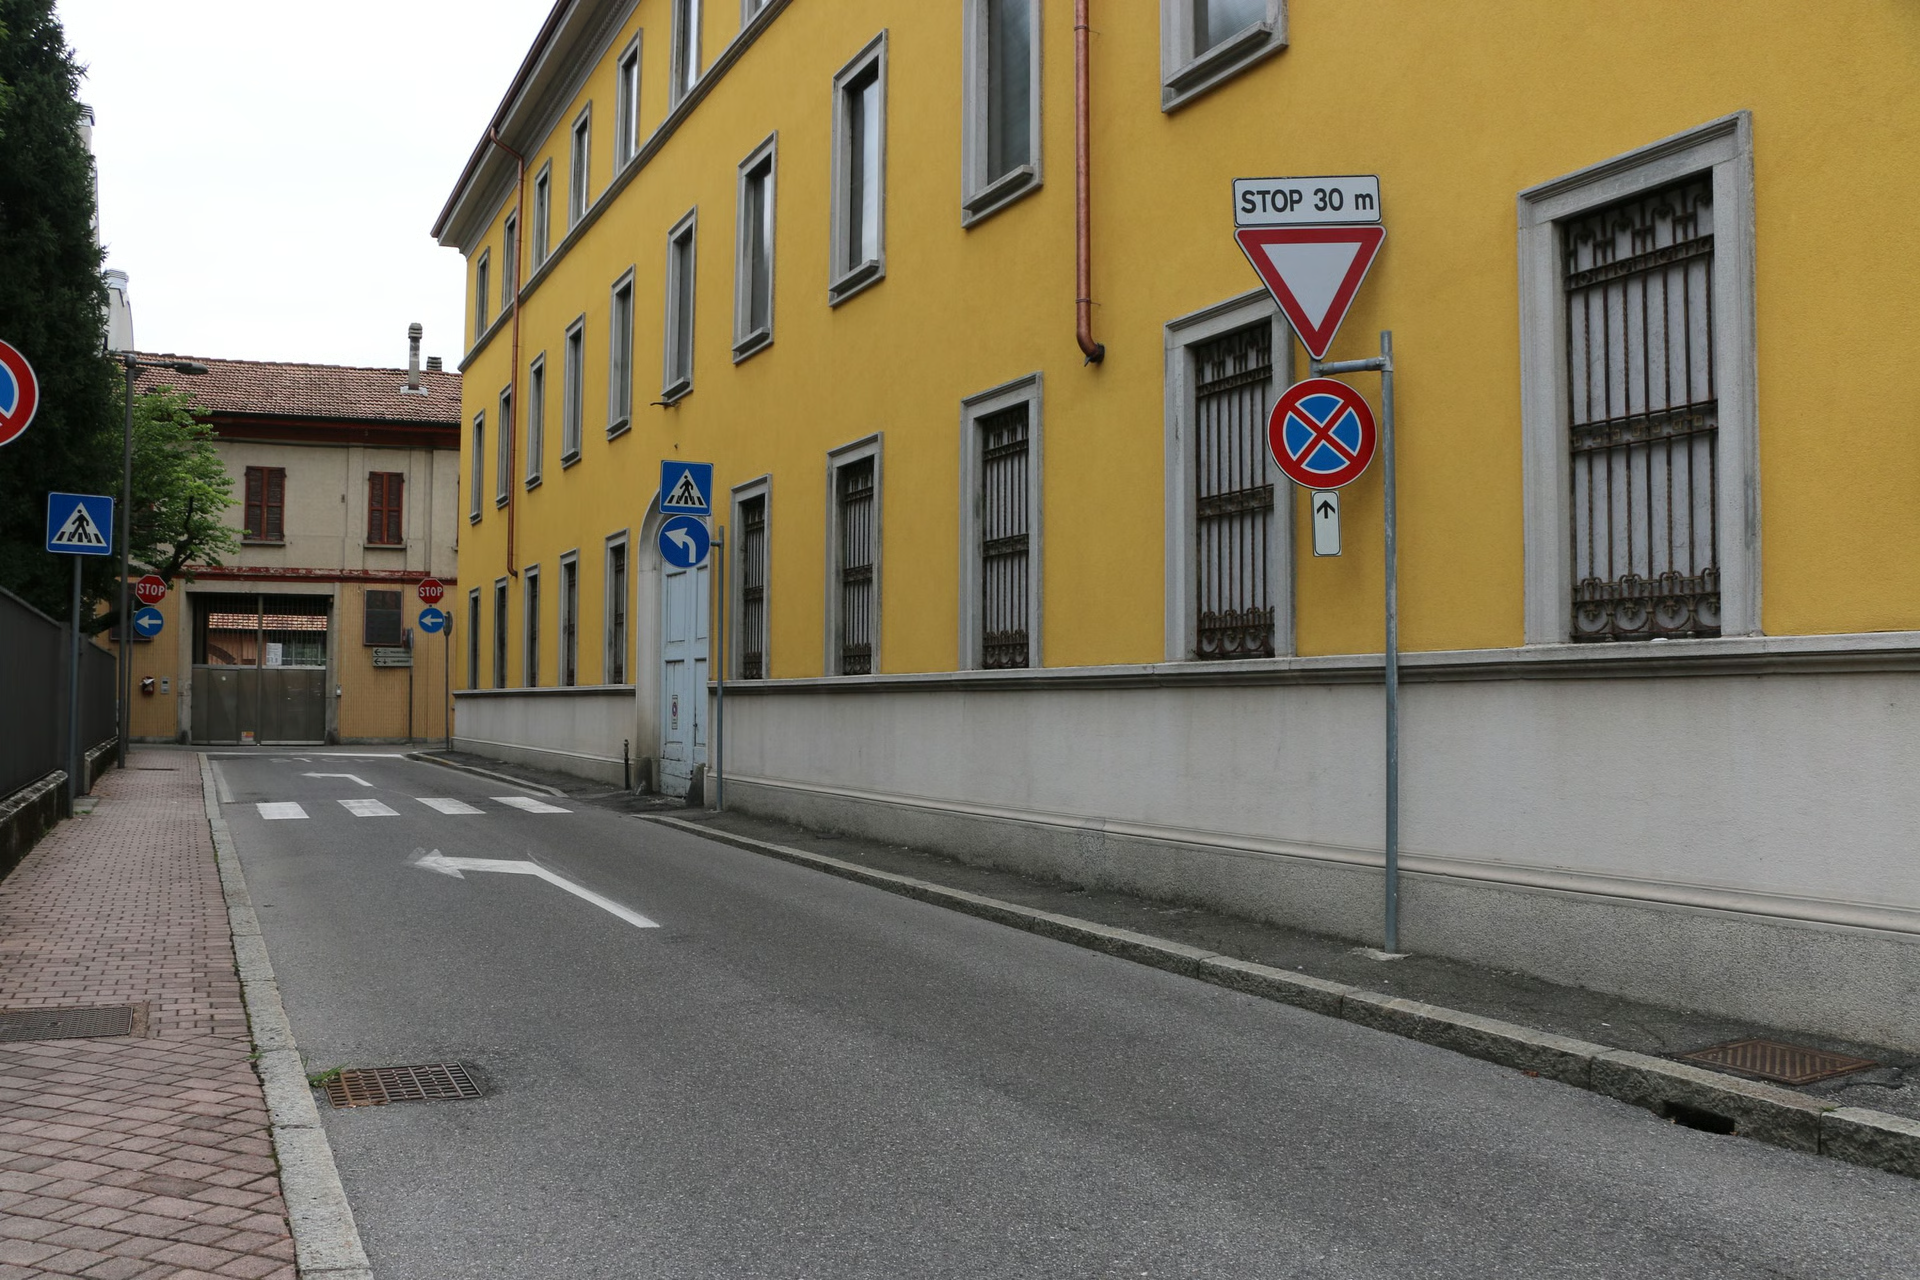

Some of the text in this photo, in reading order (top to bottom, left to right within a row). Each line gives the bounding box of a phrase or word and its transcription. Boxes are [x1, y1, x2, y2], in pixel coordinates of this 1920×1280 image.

[1241, 188, 1374, 213] STOP 30 m
[138, 583, 165, 596] STOP
[419, 586, 443, 597] STOP
